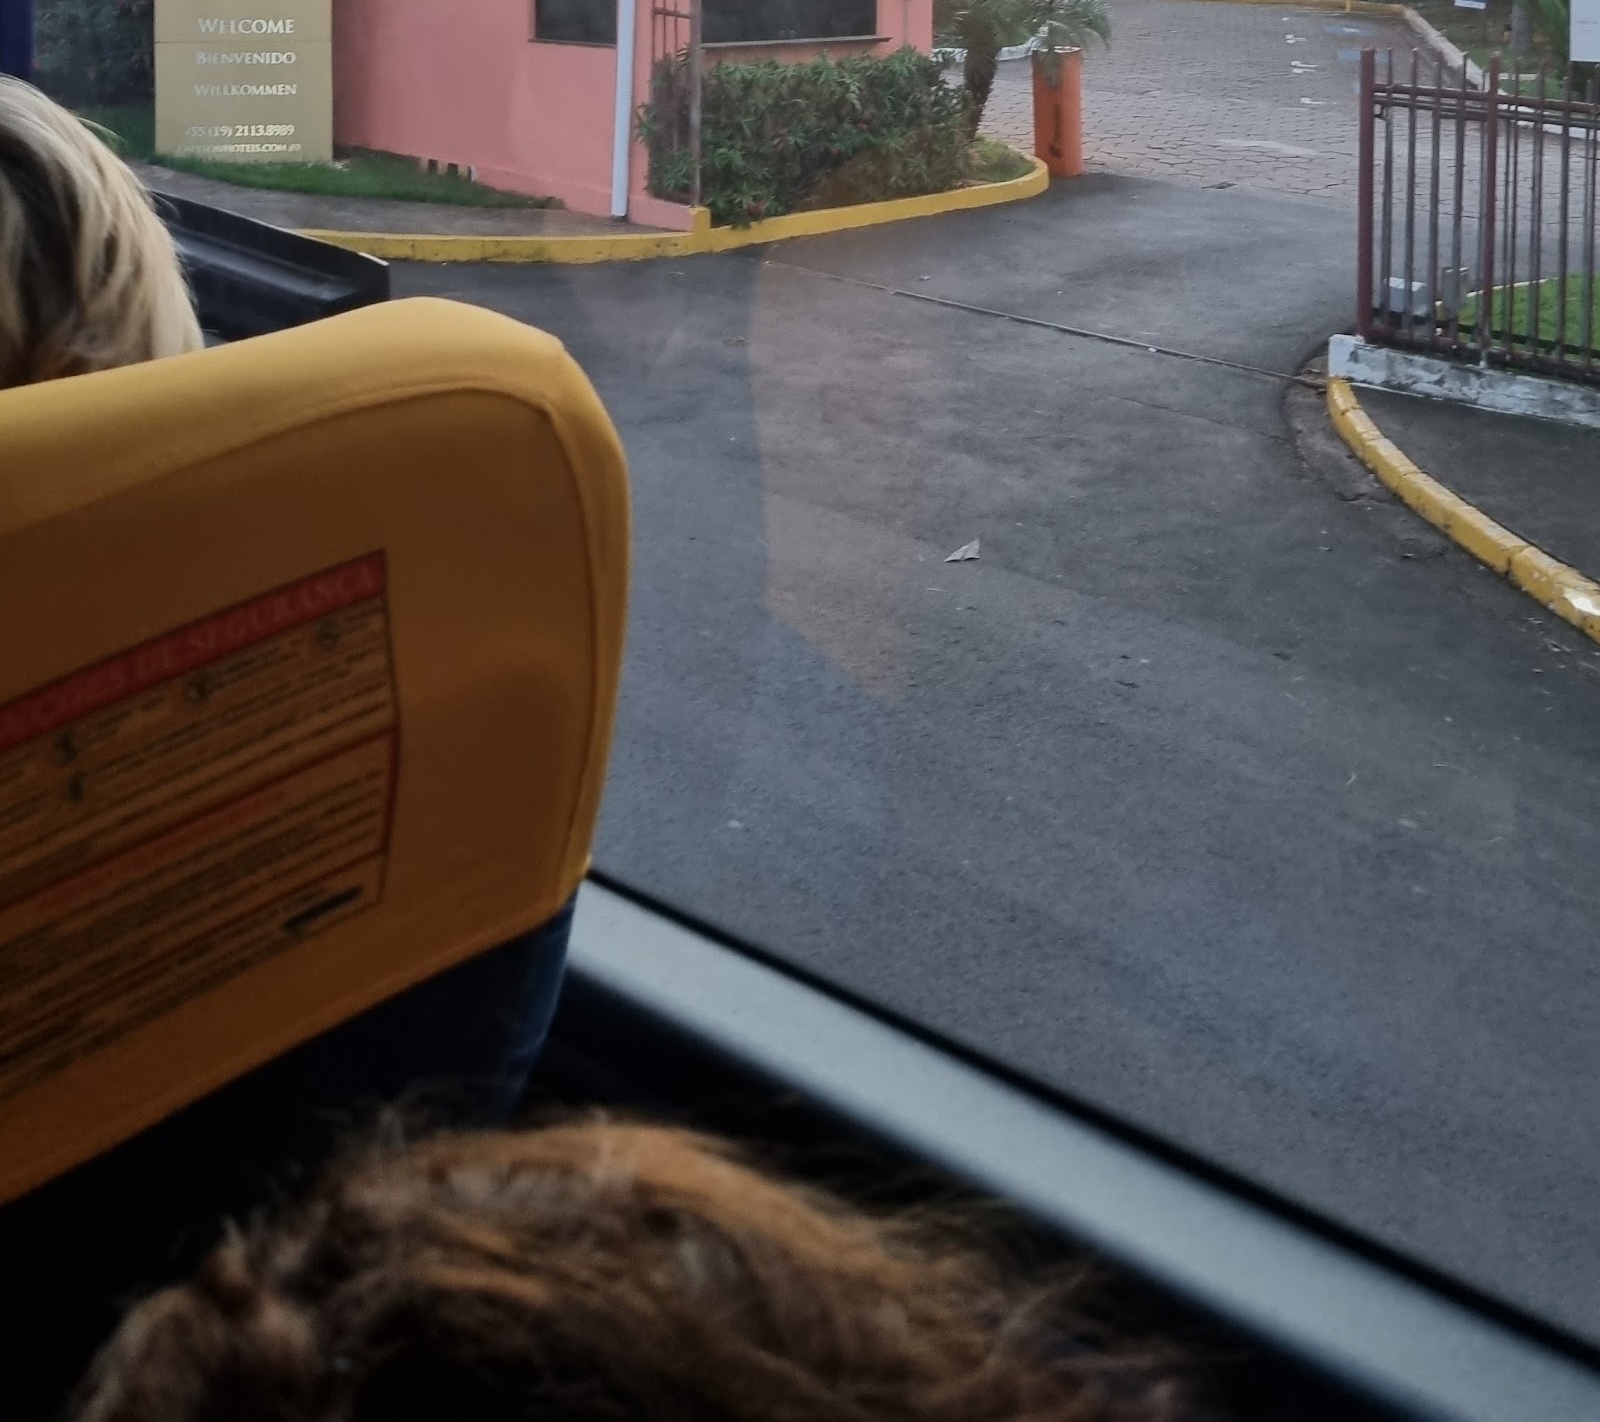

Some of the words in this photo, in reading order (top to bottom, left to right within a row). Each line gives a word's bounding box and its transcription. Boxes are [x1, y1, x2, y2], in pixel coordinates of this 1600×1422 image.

[198, 18, 295, 34] WELCOME
[196, 51, 297, 65] BIENVENIDO
[193, 83, 298, 96] WILLKOMMEN
